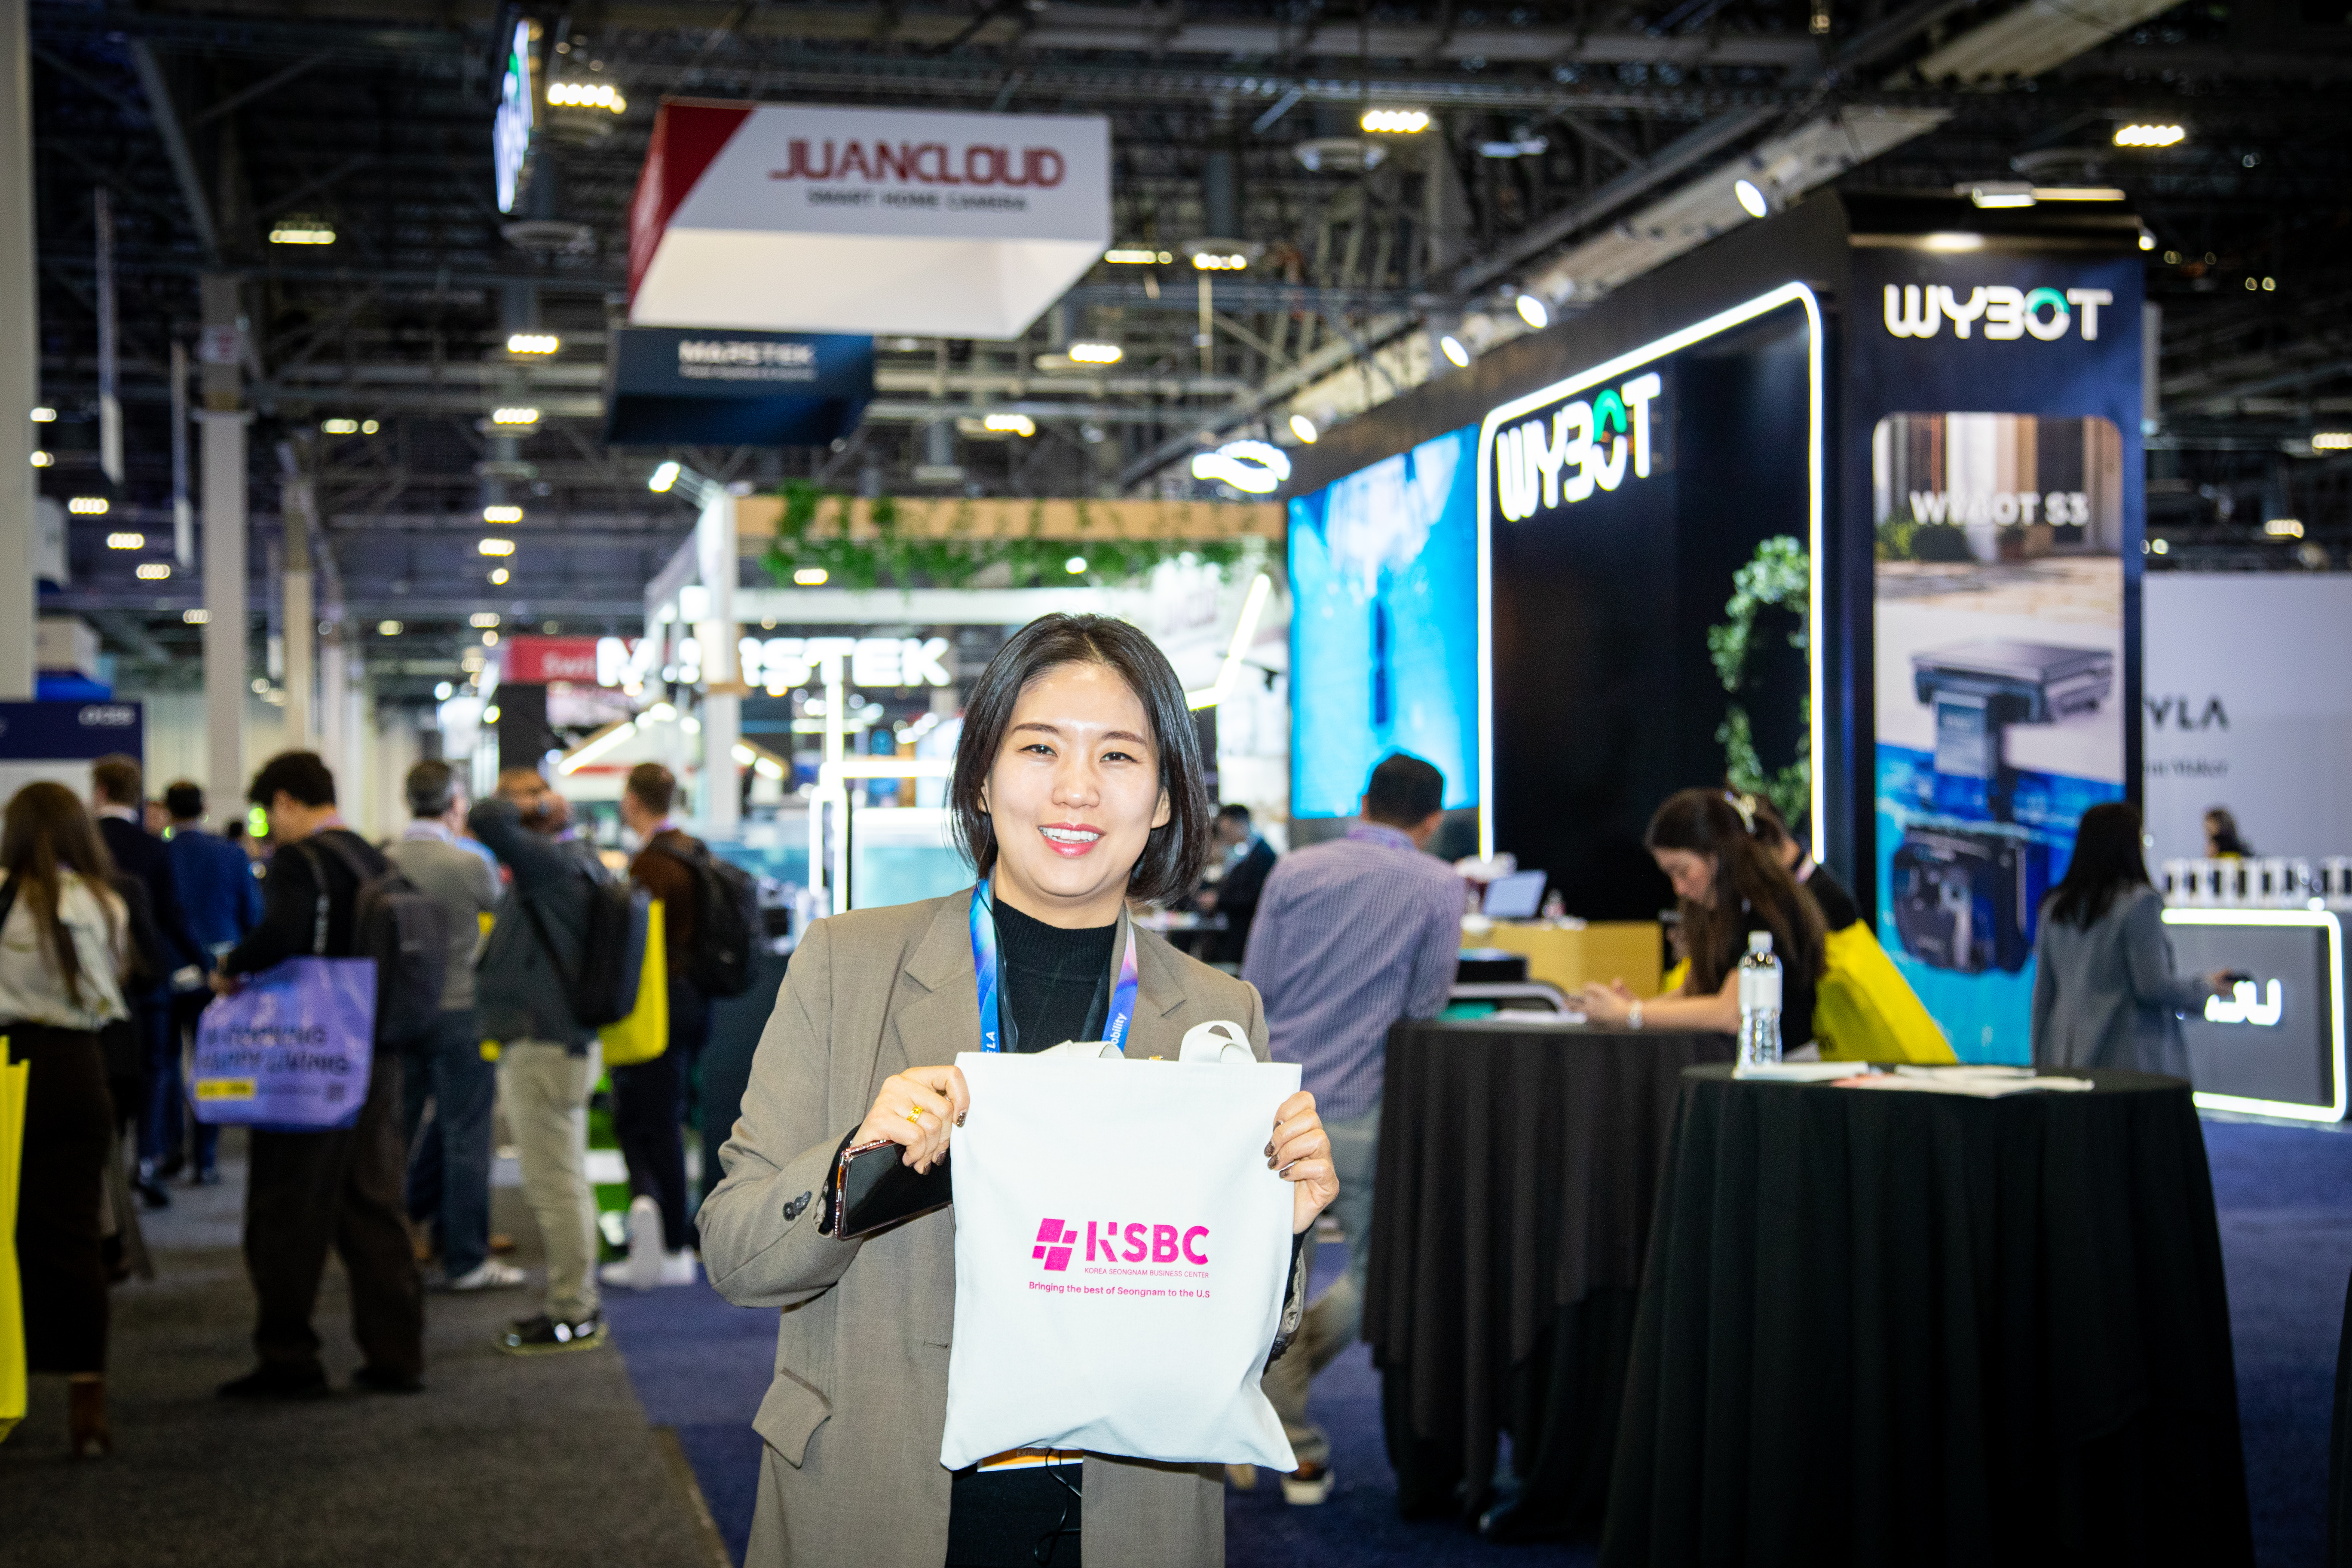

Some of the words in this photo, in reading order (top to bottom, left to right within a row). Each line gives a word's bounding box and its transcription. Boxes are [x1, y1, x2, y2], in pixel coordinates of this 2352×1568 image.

[768, 138, 1067, 189] JUANCLOUD
[1884, 284, 2113, 341] WYBOT
[1496, 372, 1662, 522] WYBOT
[1110, 1013, 1127, 1044] obility
[1085, 1221, 1210, 1265] KSBC
[1029, 1281, 1064, 1294] Bringing
[1066, 1284, 1081, 1293] the
[1084, 1286, 1104, 1294] best
[1106, 1286, 1115, 1295] of
[1117, 1286, 1166, 1298] Seongnam
[1168, 1289, 1177, 1297] to
[1179, 1289, 1194, 1297] the
[1184, 1271, 1209, 1279] CENTER
